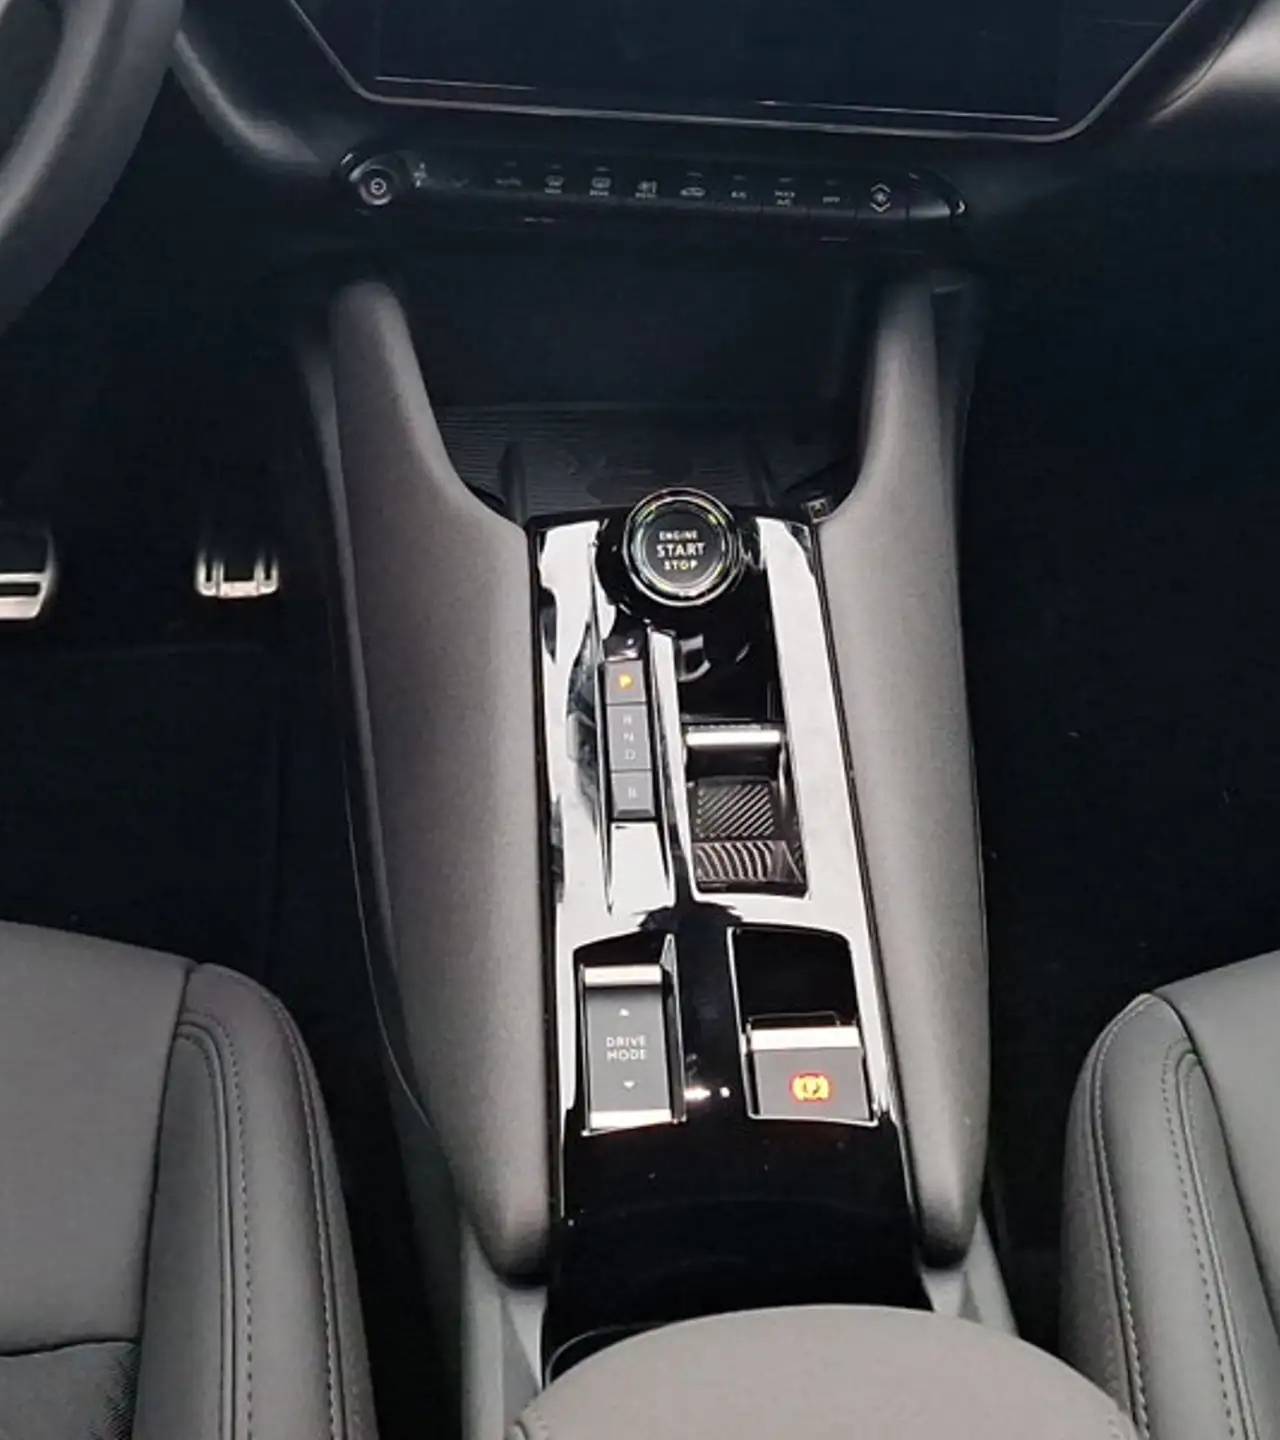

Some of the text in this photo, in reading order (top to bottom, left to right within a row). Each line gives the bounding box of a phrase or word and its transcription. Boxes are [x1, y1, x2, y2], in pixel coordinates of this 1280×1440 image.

[656, 542, 706, 558] START
[663, 559, 699, 571] STOP
[605, 1034, 647, 1049] DRIVE
[606, 1048, 648, 1063] MODE
